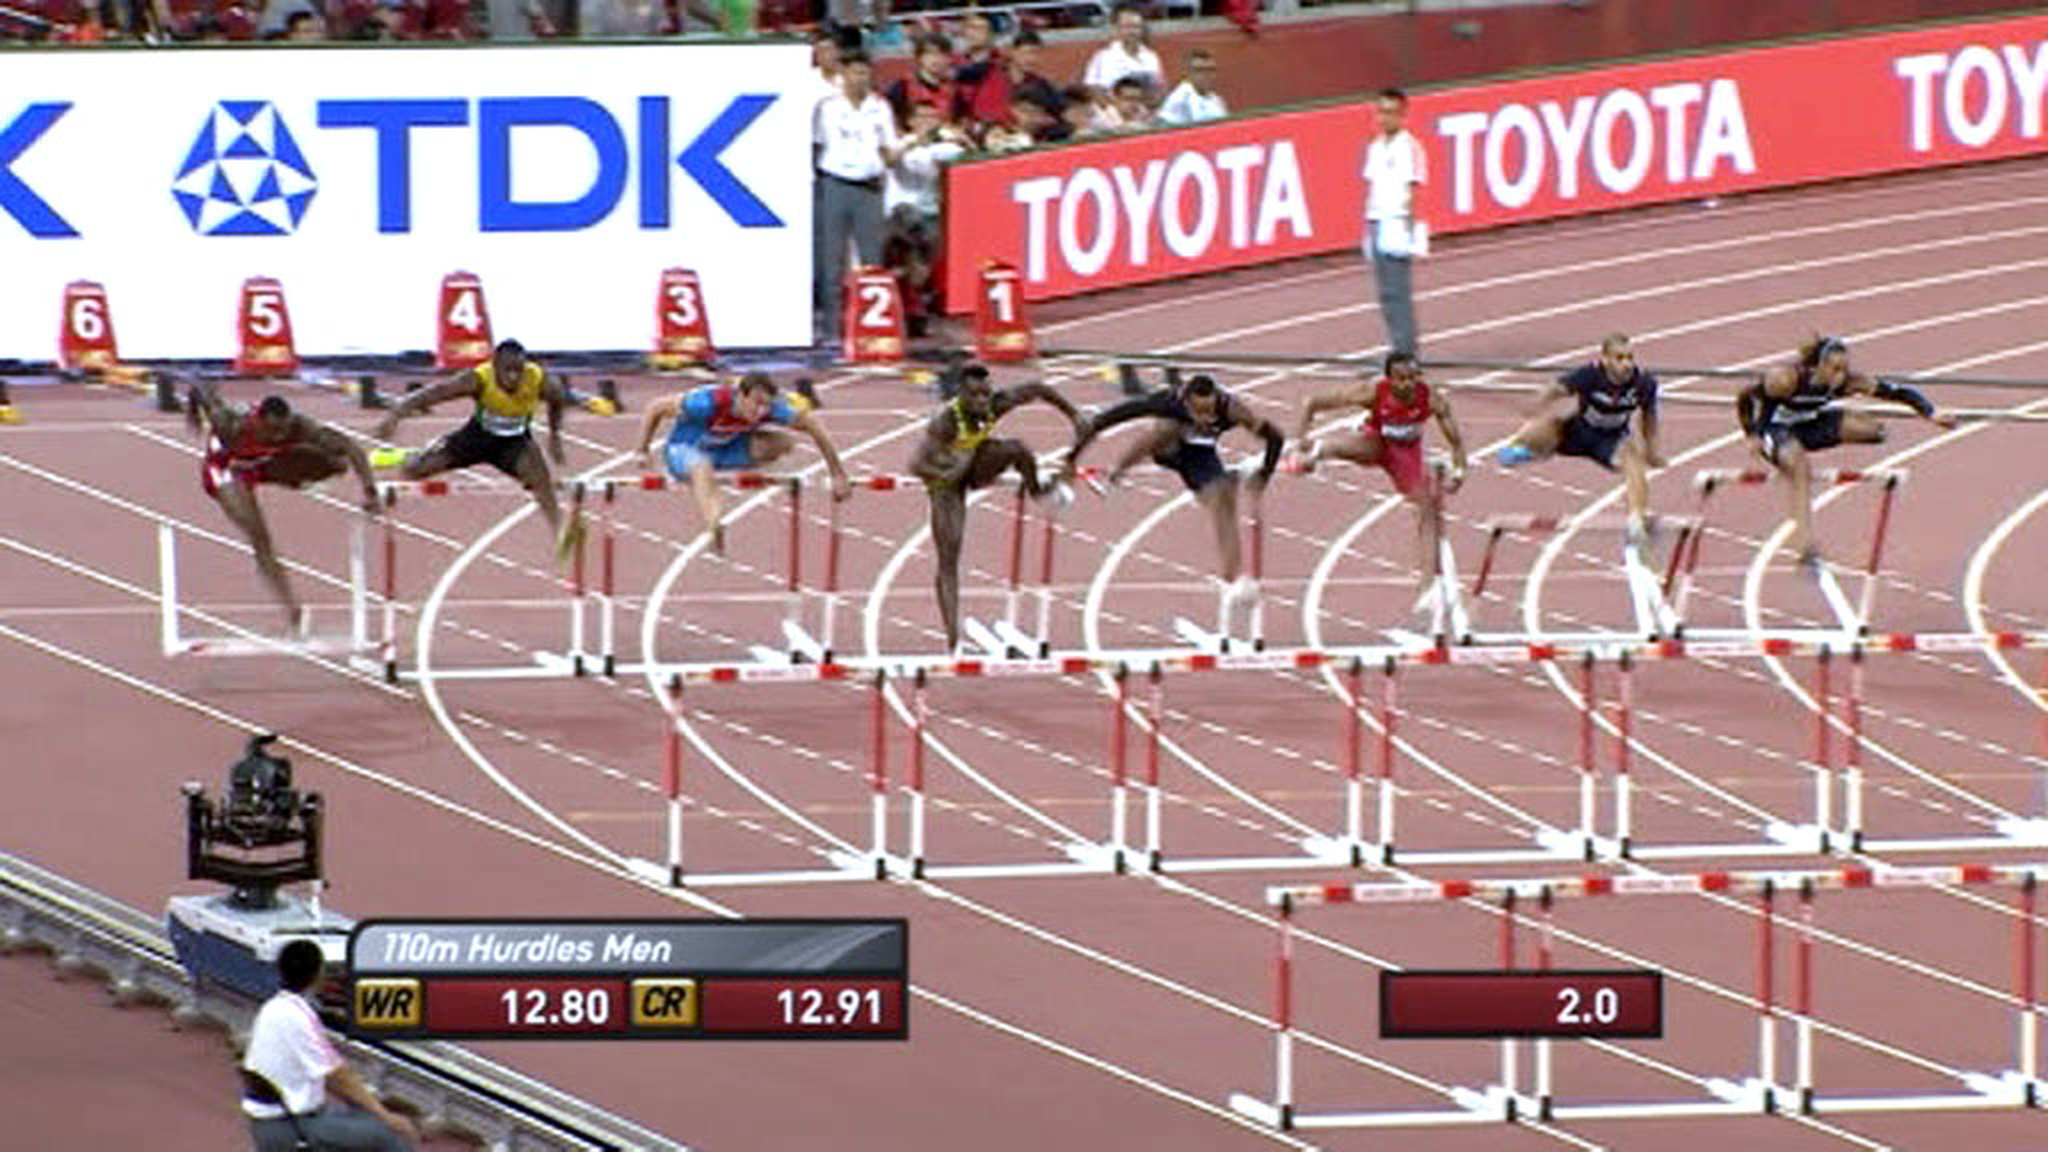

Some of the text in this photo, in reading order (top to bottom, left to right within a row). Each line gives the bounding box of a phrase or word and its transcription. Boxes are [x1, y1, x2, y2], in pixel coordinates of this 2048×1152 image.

[315, 94, 788, 234] TDK
[1437, 78, 1757, 214] TOYOTA
[1012, 140, 1313, 283] TOYOTA
[71, 297, 103, 339] 6
[249, 293, 282, 336] 5
[446, 290, 480, 332] 4
[666, 285, 699, 326] 3
[860, 285, 892, 328] 2
[985, 282, 1015, 322] 1
